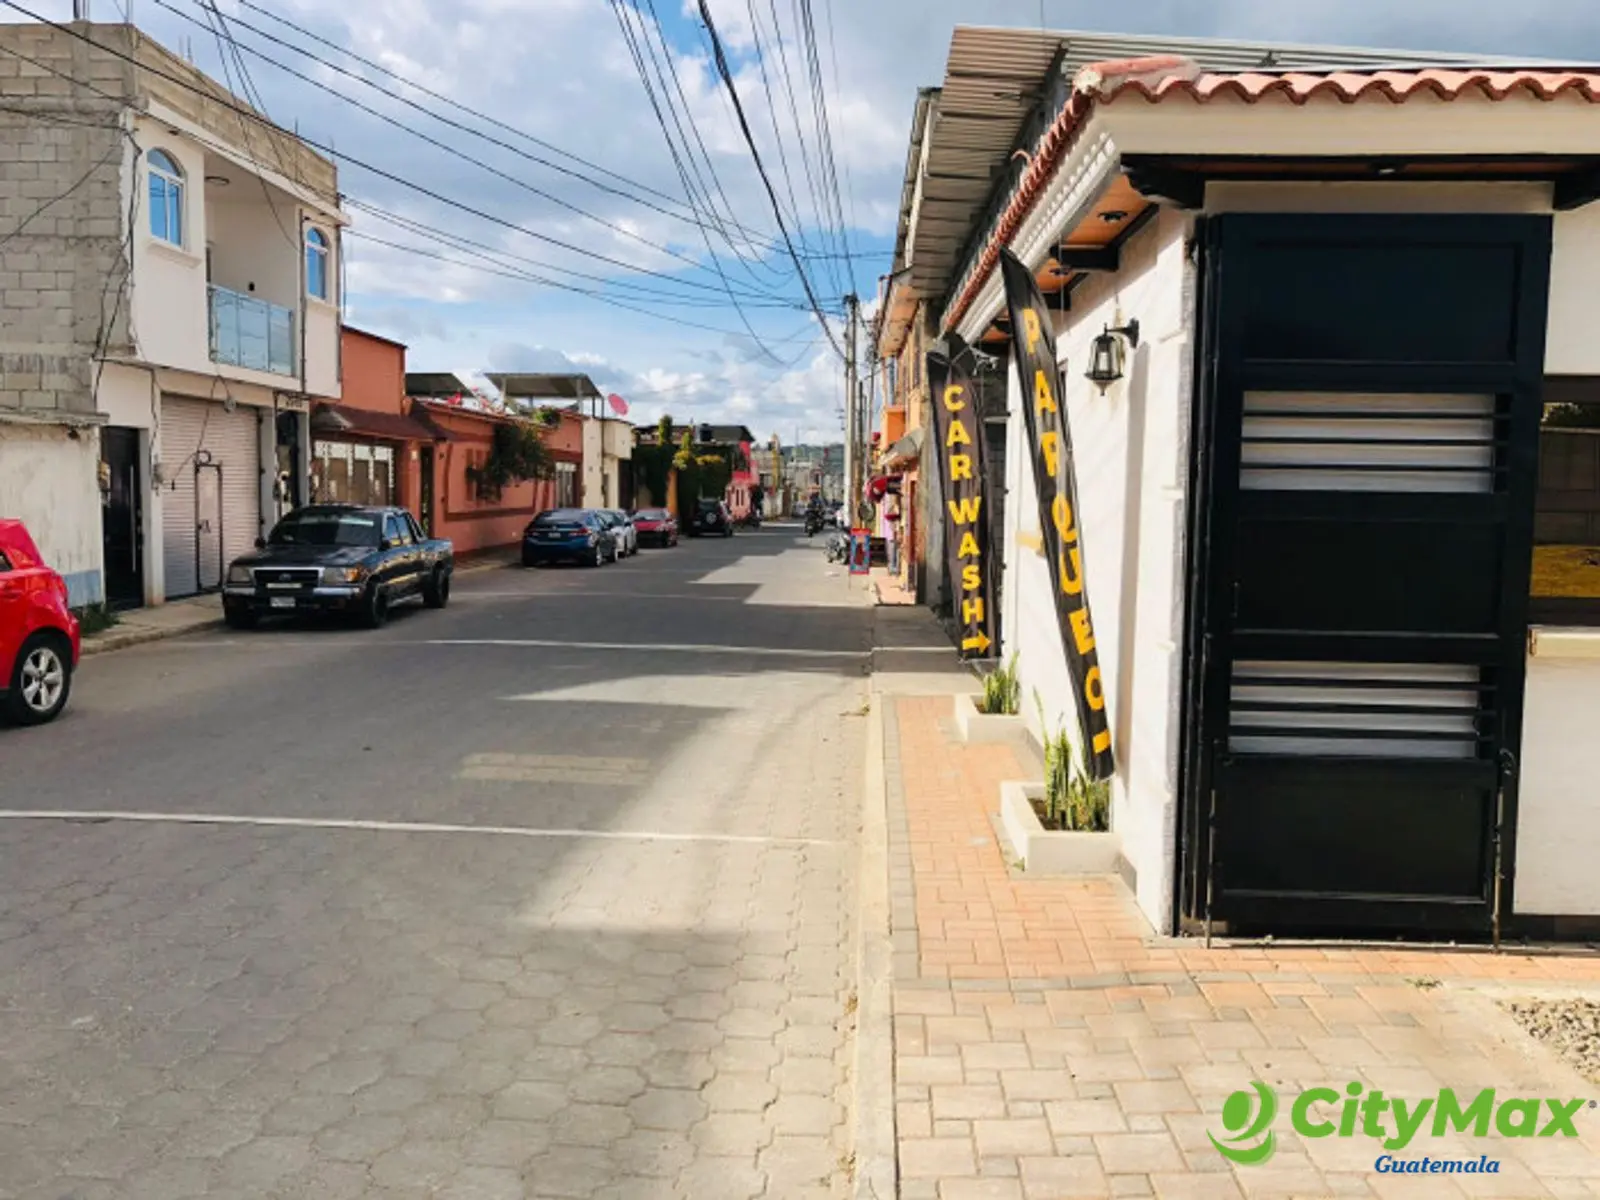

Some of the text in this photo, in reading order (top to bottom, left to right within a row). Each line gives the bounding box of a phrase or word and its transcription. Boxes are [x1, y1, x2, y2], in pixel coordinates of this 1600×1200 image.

[943, 385, 984, 625] CAR WASH
[1023, 308, 1105, 711] PARQUEO
